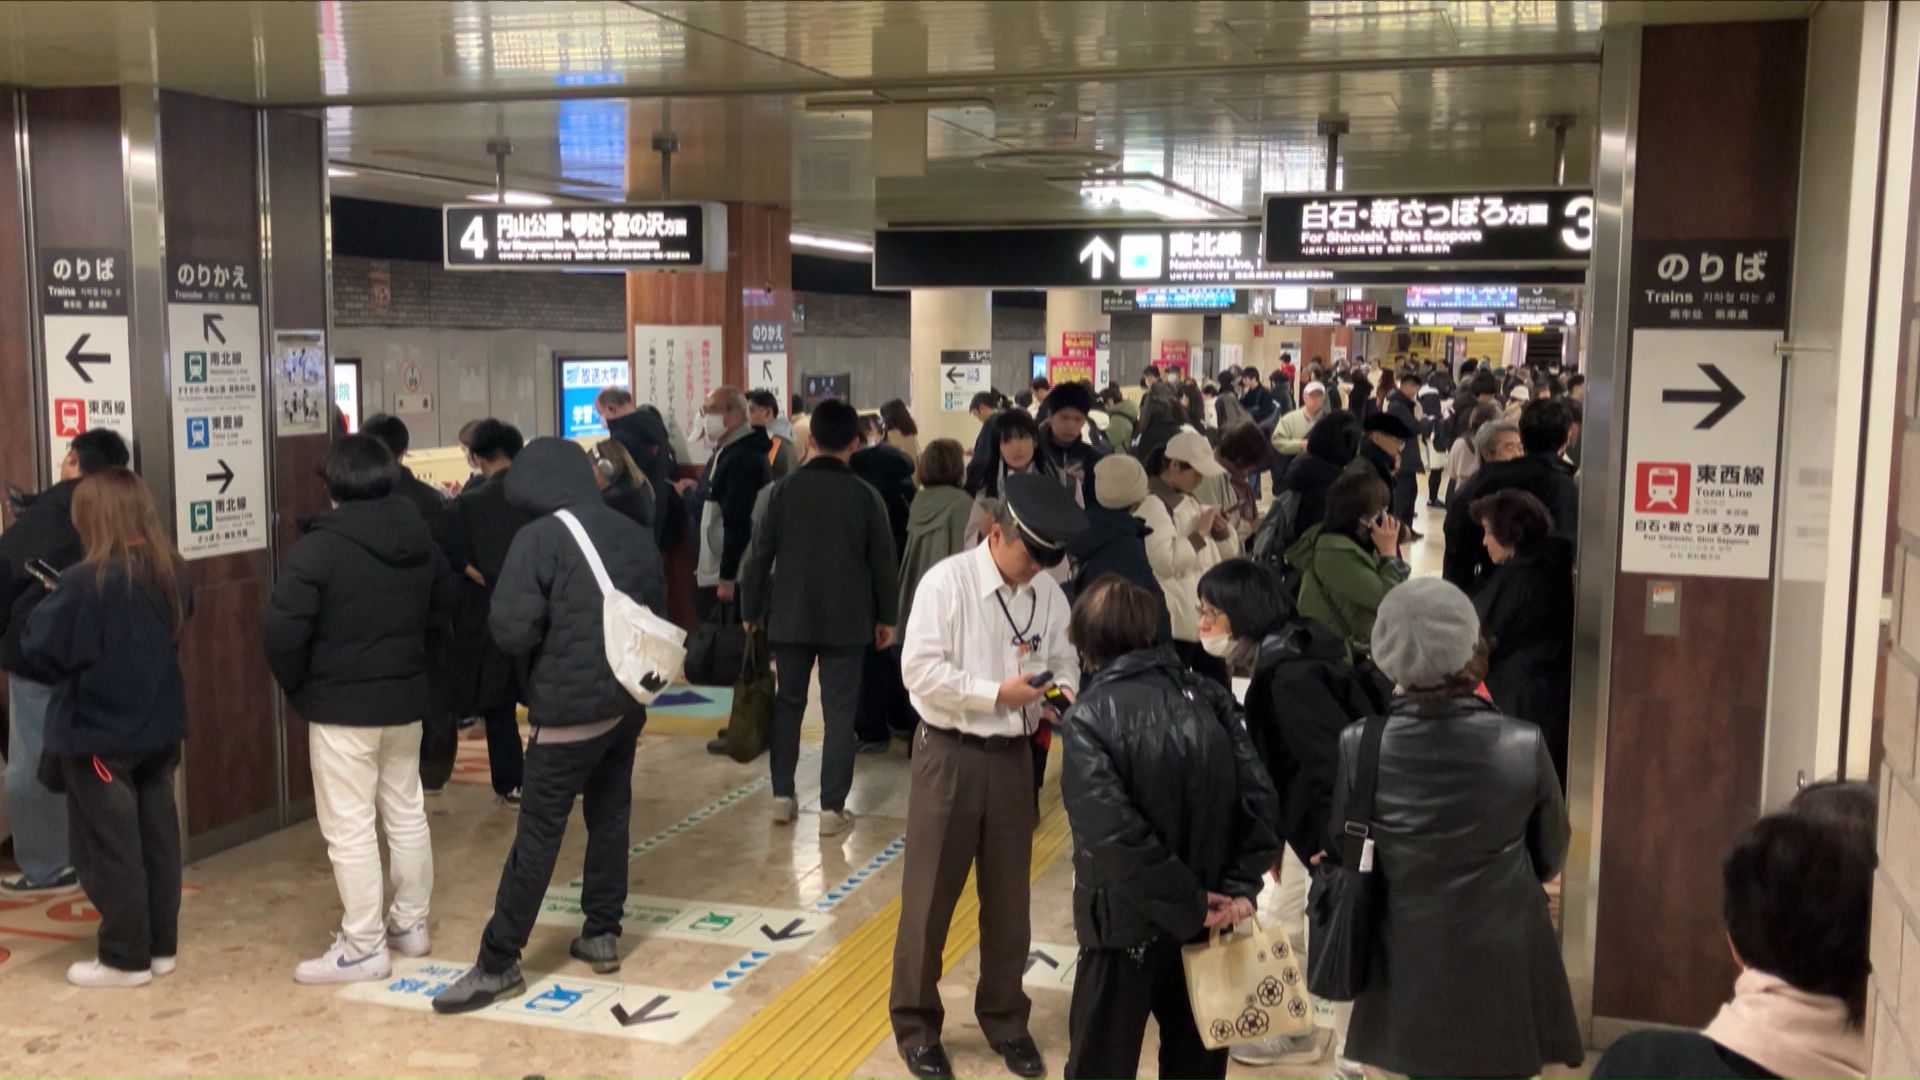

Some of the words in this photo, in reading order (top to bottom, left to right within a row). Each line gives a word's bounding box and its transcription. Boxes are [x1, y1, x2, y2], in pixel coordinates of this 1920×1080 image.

[1301, 196, 1549, 231] 白石・新さっぽろ方面
[1562, 195, 1593, 251] 3
[460, 214, 488, 260] 4
[1301, 230, 1324, 244] For
[1390, 230, 1421, 244] Shin
[1423, 229, 1483, 247] Sapporo
[53, 256, 114, 282] のりば
[177, 262, 249, 289] のりかえ
[1656, 250, 1768, 283] のりば
[48, 284, 76, 298] Trains
[1645, 289, 1694, 304] Trains
[752, 324, 783, 342] のりかえ
[210, 351, 242, 367] 南北線
[581, 367, 620, 385] 放送大学
[88, 399, 126, 416] 東西線
[1696, 463, 1765, 486] 東西線
[1696, 486, 1726, 498] Tozai
[1728, 487, 1753, 499] Line
[215, 496, 247, 514] 南北線
[1635, 518, 1760, 537] 白石・新さっぽろ方面
